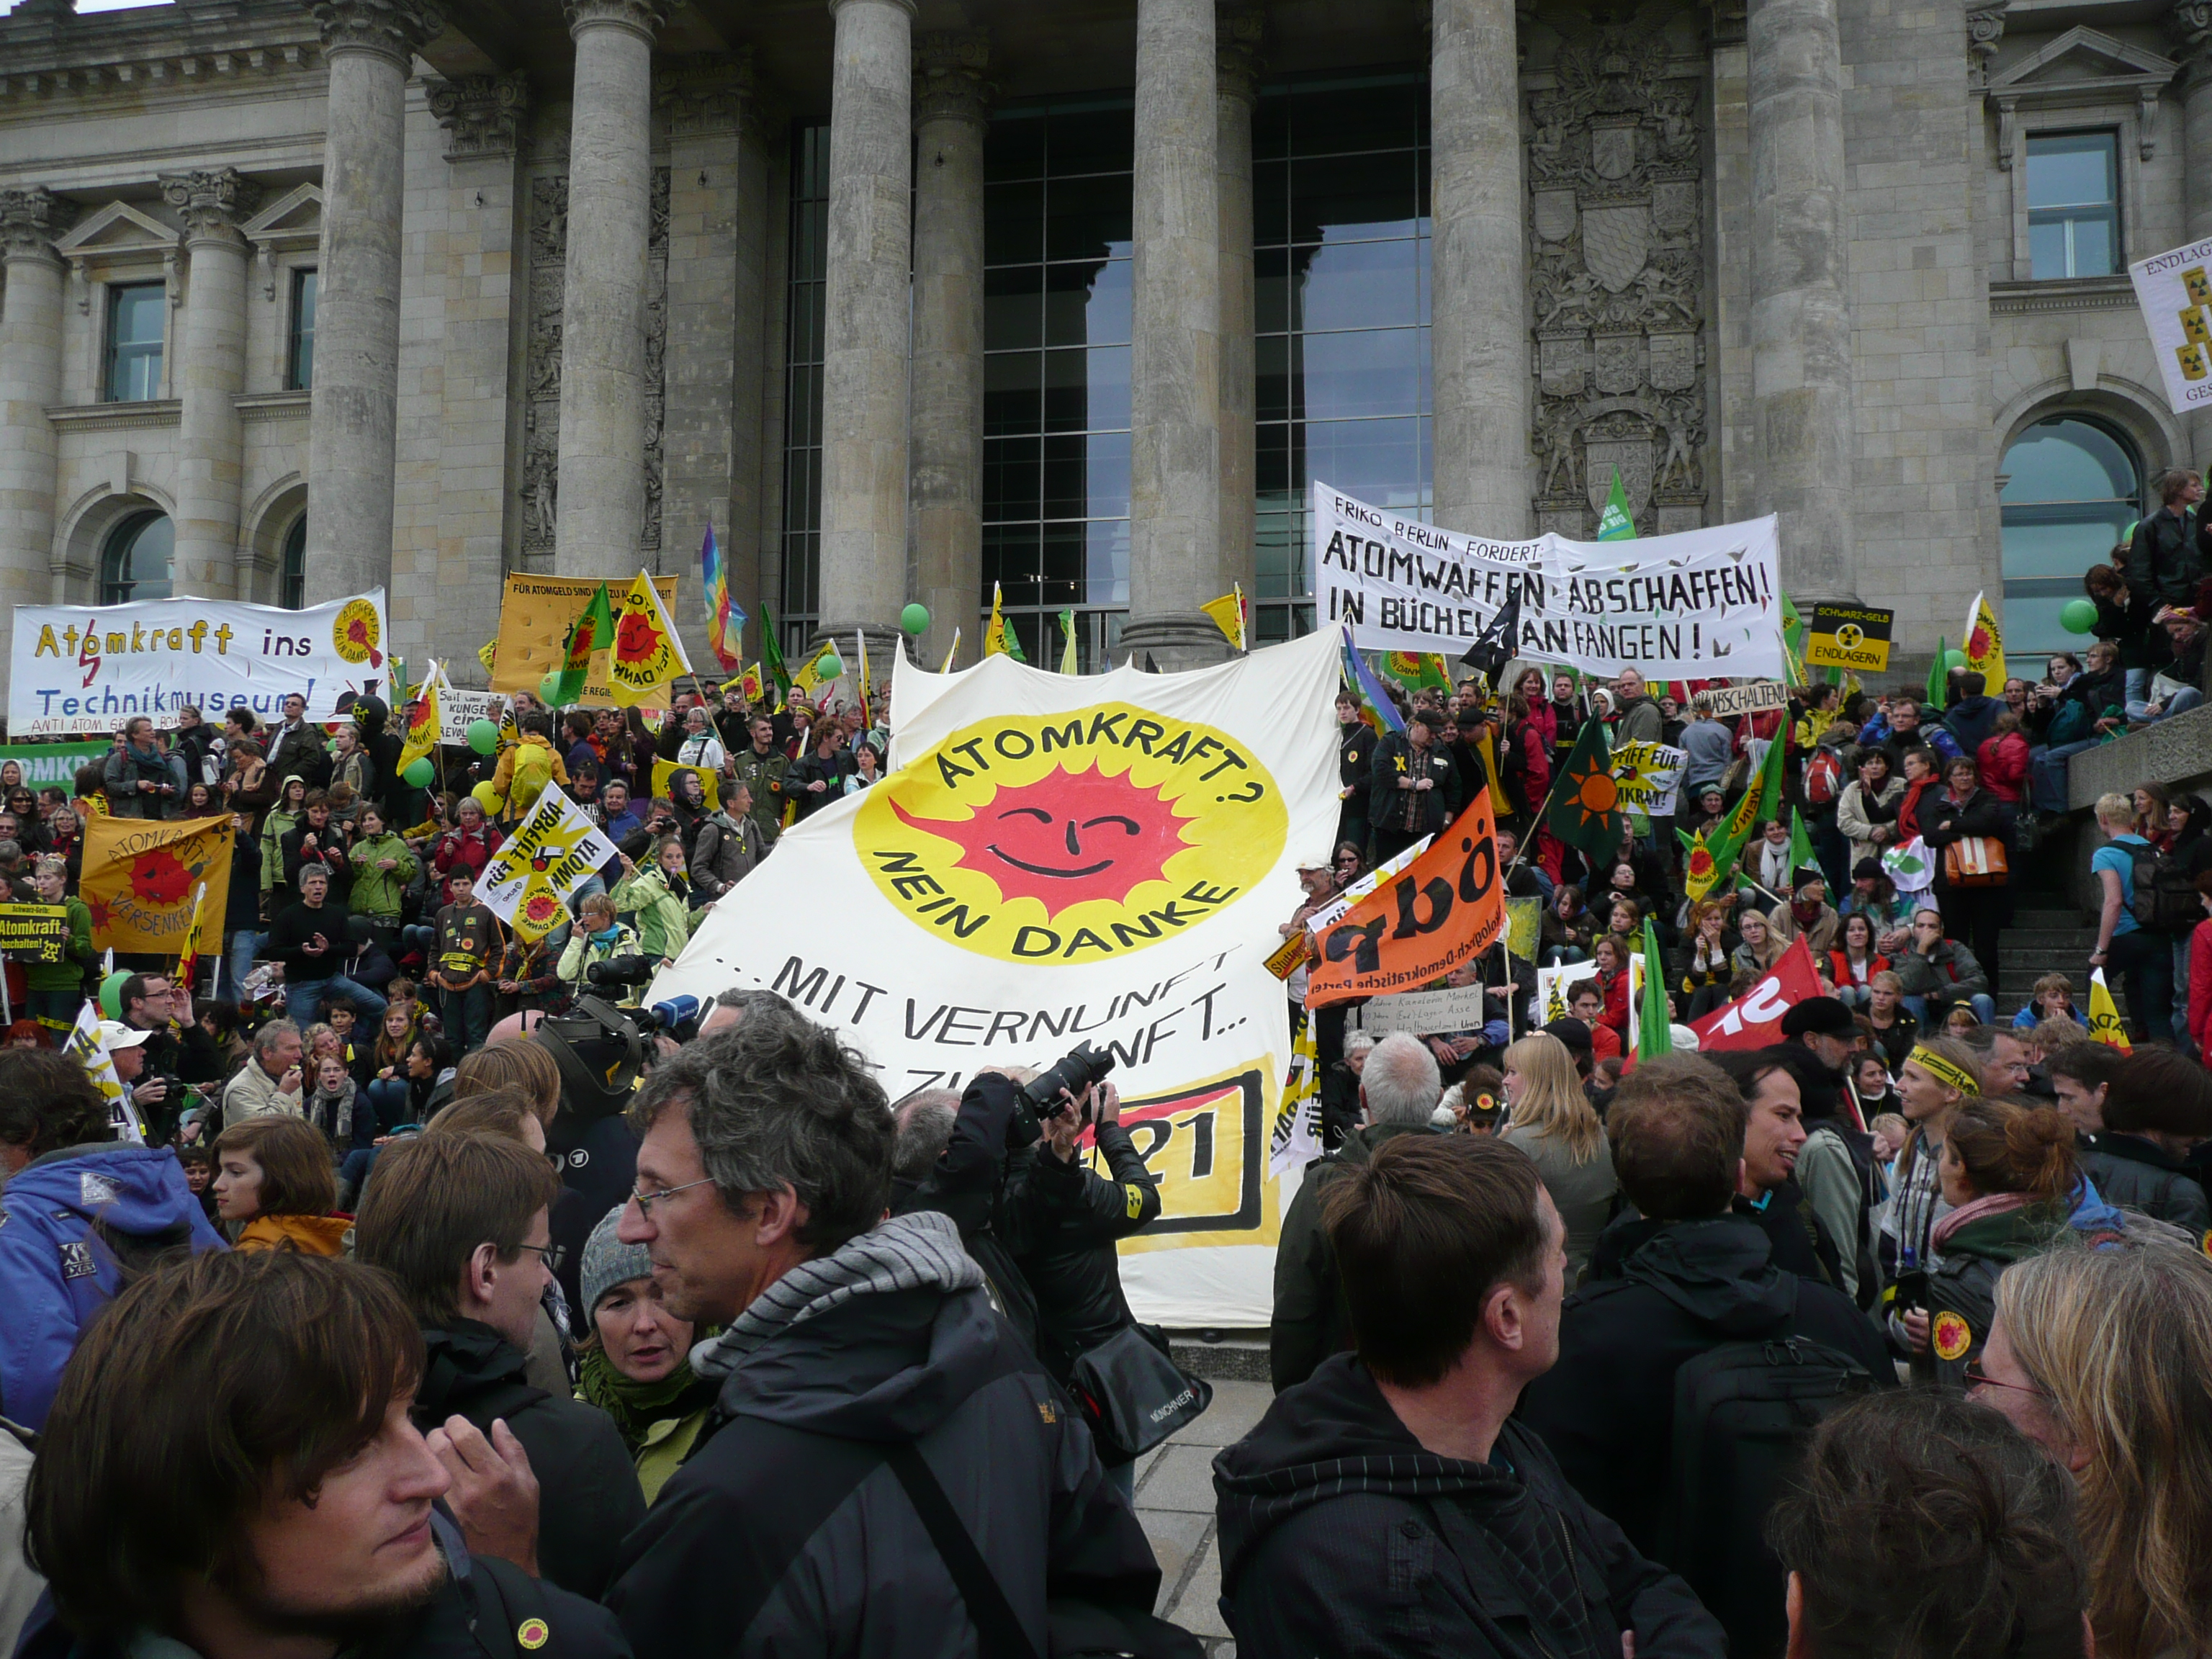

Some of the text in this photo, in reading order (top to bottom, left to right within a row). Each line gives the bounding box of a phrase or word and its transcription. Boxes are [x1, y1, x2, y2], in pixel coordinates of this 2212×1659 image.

[2145, 242, 2212, 276] ENDLAG
[1335, 496, 1382, 527] FRIKO
[1395, 521, 1449, 552] BERLIN
[1322, 530, 1773, 615] ATOMWAFFEN ABSCHAFFEN!
[513, 583, 531, 593] FÜR
[531, 585, 572, 596] ATOMGELD
[574, 587, 591, 596] SIND
[609, 588, 621, 598] ZU
[658, 590, 673, 599] REIT.
[1329, 586, 1364, 625] IN
[1817, 606, 1890, 624] SCHWARZ-GELB
[35, 619, 312, 658] Atomkraft ins
[1815, 646, 1881, 665] ENDLAGERN
[439, 691, 461, 702] Seit
[589, 686, 612, 697] REGIE
[31, 719, 64, 732] ANTI
[71, 719, 102, 731] ATOM
[935, 710, 1265, 804] ATOMKRAFT?
[1650, 749, 1680, 773] FÜR
[872, 849, 1240, 959] NEIN DANKE
[0, 919, 61, 935] Atomkraft
[1, 938, 42, 949] bschalten!
[904, 943, 1244, 1046] VERNUNFT
[1446, 989, 1480, 1002] Merkel
[1460, 1020, 1481, 1029] Uran
[1150, 1389, 1195, 1424] MÜNCHNER
